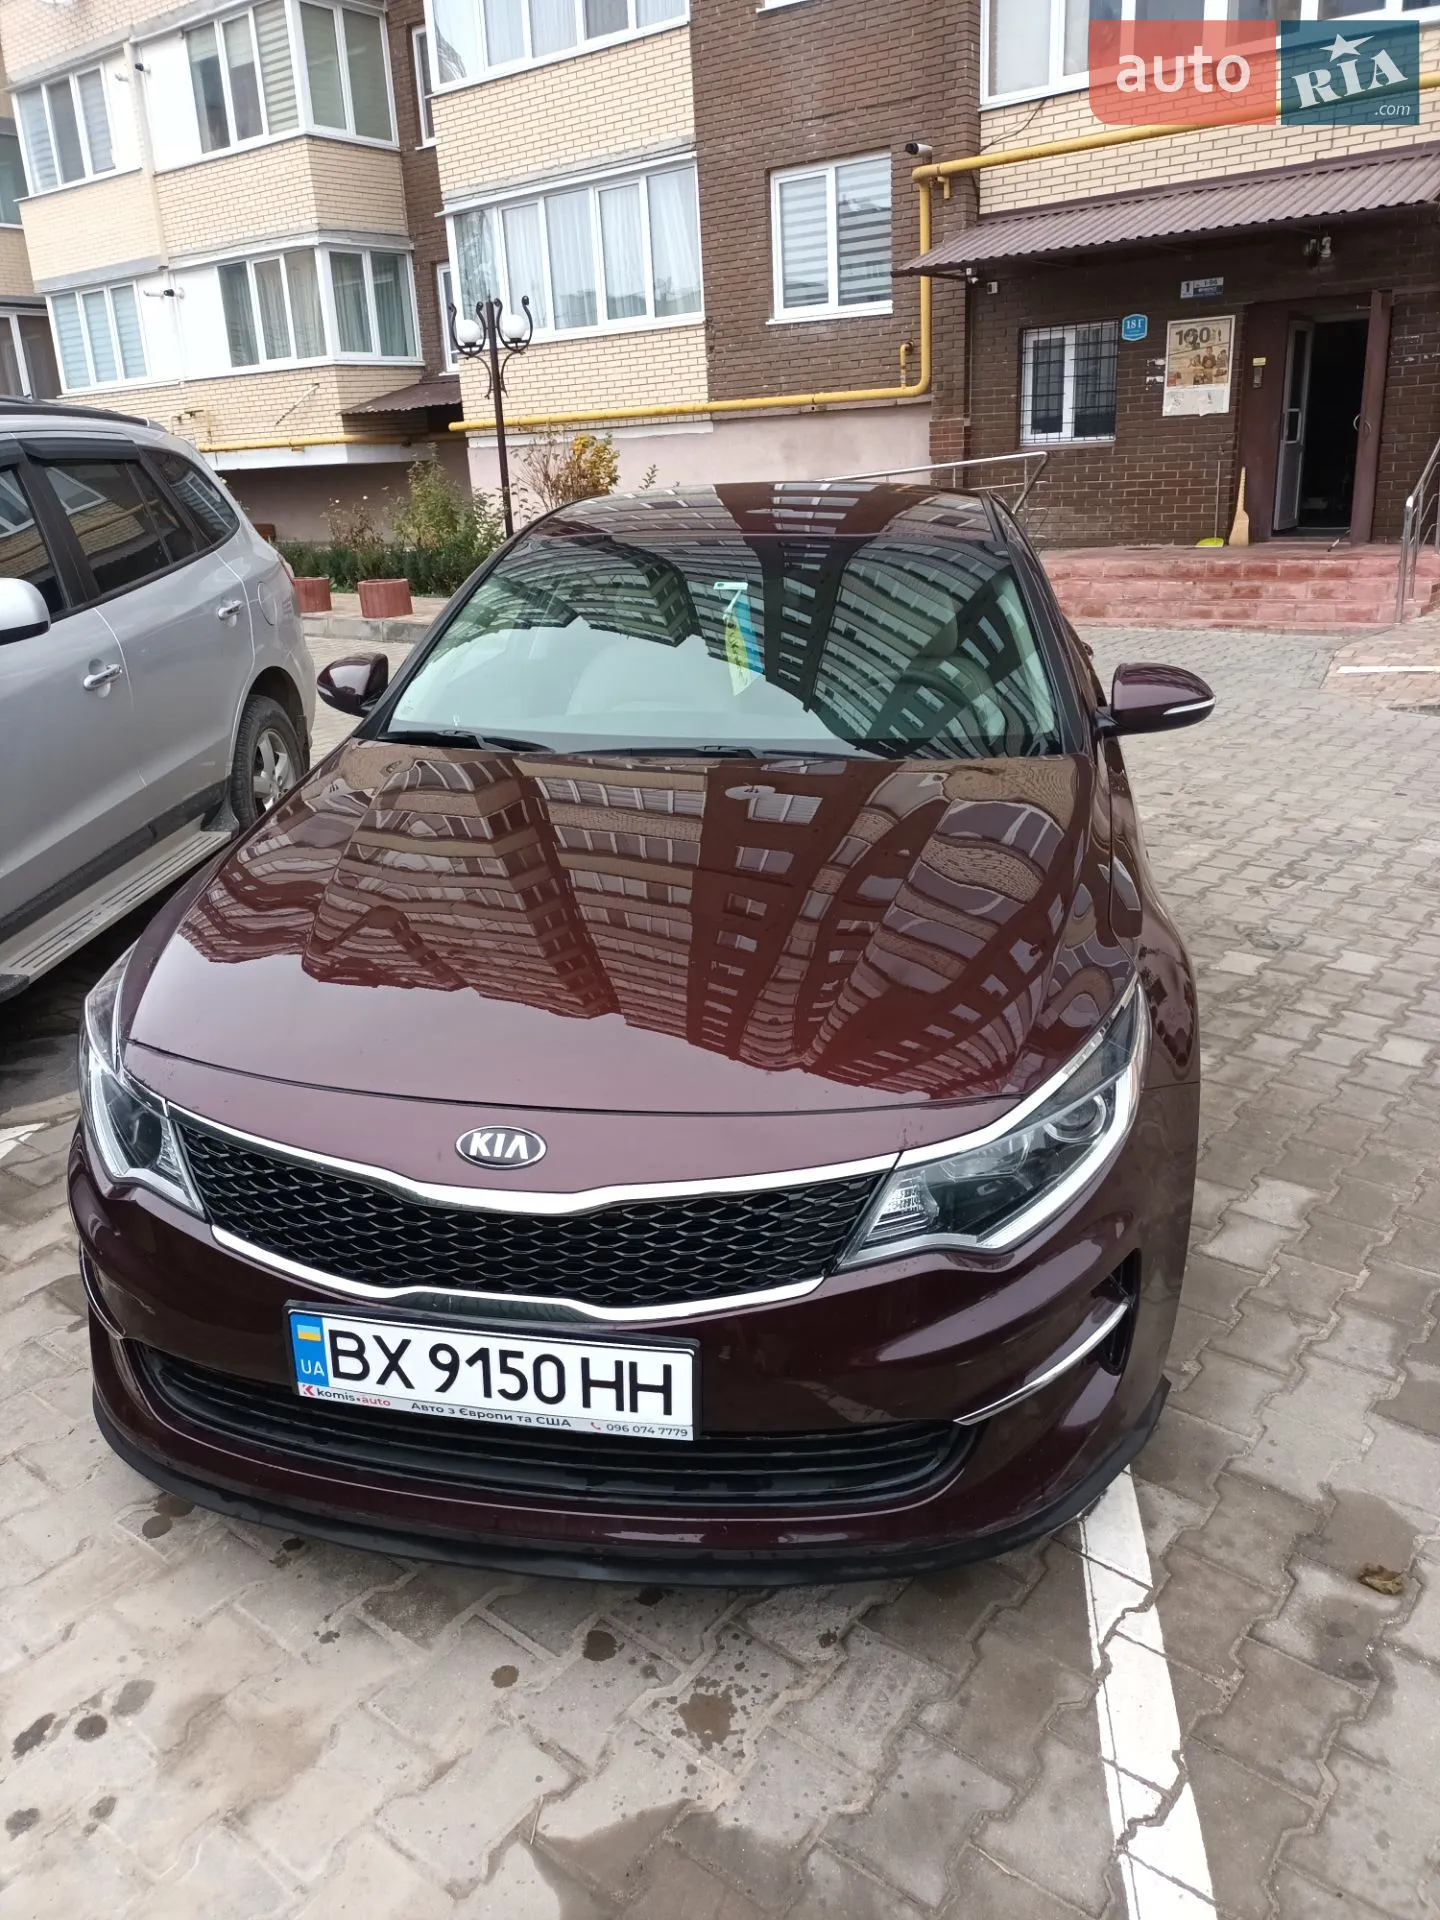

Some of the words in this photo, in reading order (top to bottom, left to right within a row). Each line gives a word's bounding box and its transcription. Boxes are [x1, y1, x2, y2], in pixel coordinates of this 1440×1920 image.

[469, 1132, 529, 1160] KIA
[300, 1359, 325, 1377] UA
[328, 1329, 415, 1390] BX
[429, 1343, 565, 1405] 9150
[581, 1357, 672, 1416] HH
[411, 1402, 444, 1413] Авто
[459, 1408, 514, 1421] Європи
[516, 1415, 532, 1424] та
[536, 1416, 572, 1427] США
[606, 1423, 630, 1432] 096
[632, 1425, 655, 1434] 074
[658, 1427, 688, 1437] 7779
